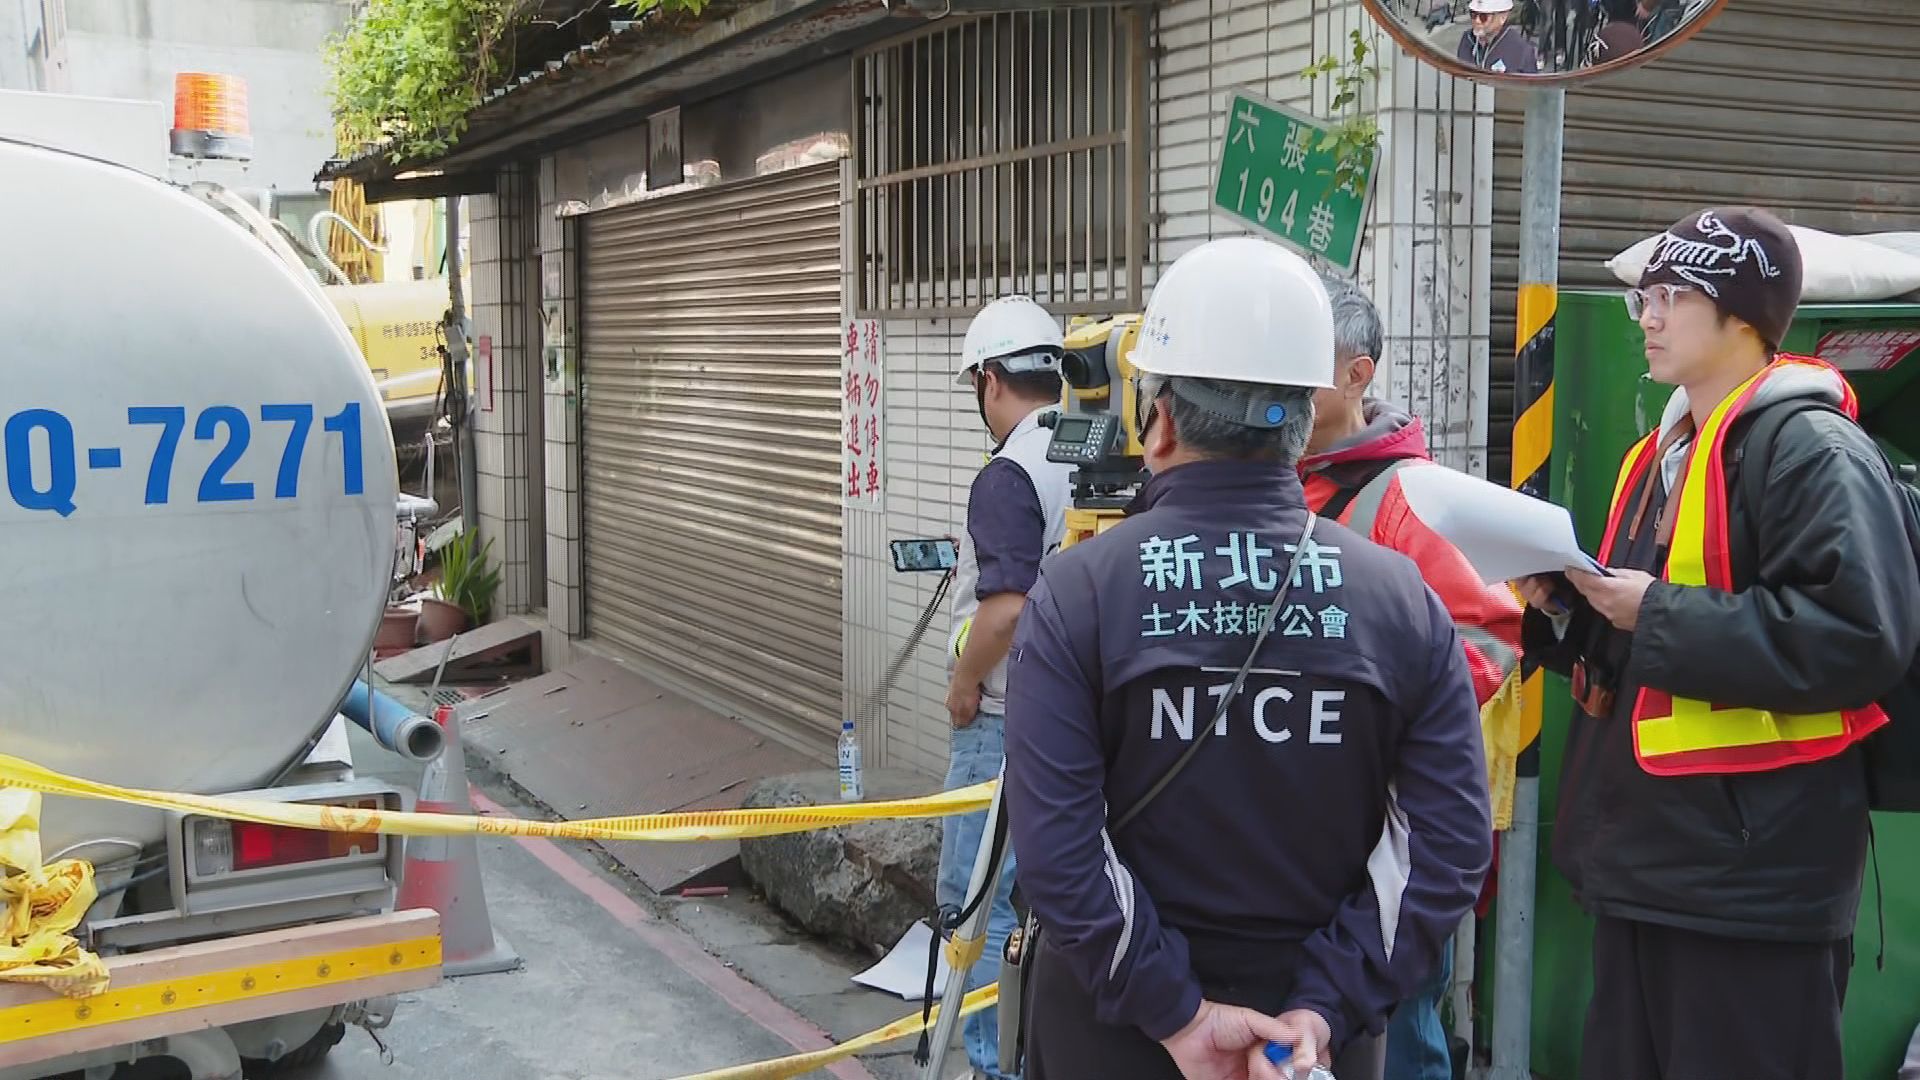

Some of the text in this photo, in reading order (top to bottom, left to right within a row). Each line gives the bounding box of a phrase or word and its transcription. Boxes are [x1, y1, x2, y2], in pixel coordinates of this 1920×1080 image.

[1237, 167, 1335, 252] 194巷
[845, 321, 862, 500] 車輛進出
[864, 320, 880, 504] 請勿停車
[4, 401, 364, 518] Q-7271
[1139, 531, 1344, 594] 新北市
[1140, 600, 1350, 640] 土木技師公會
[1150, 683, 1346, 745] NTCE
